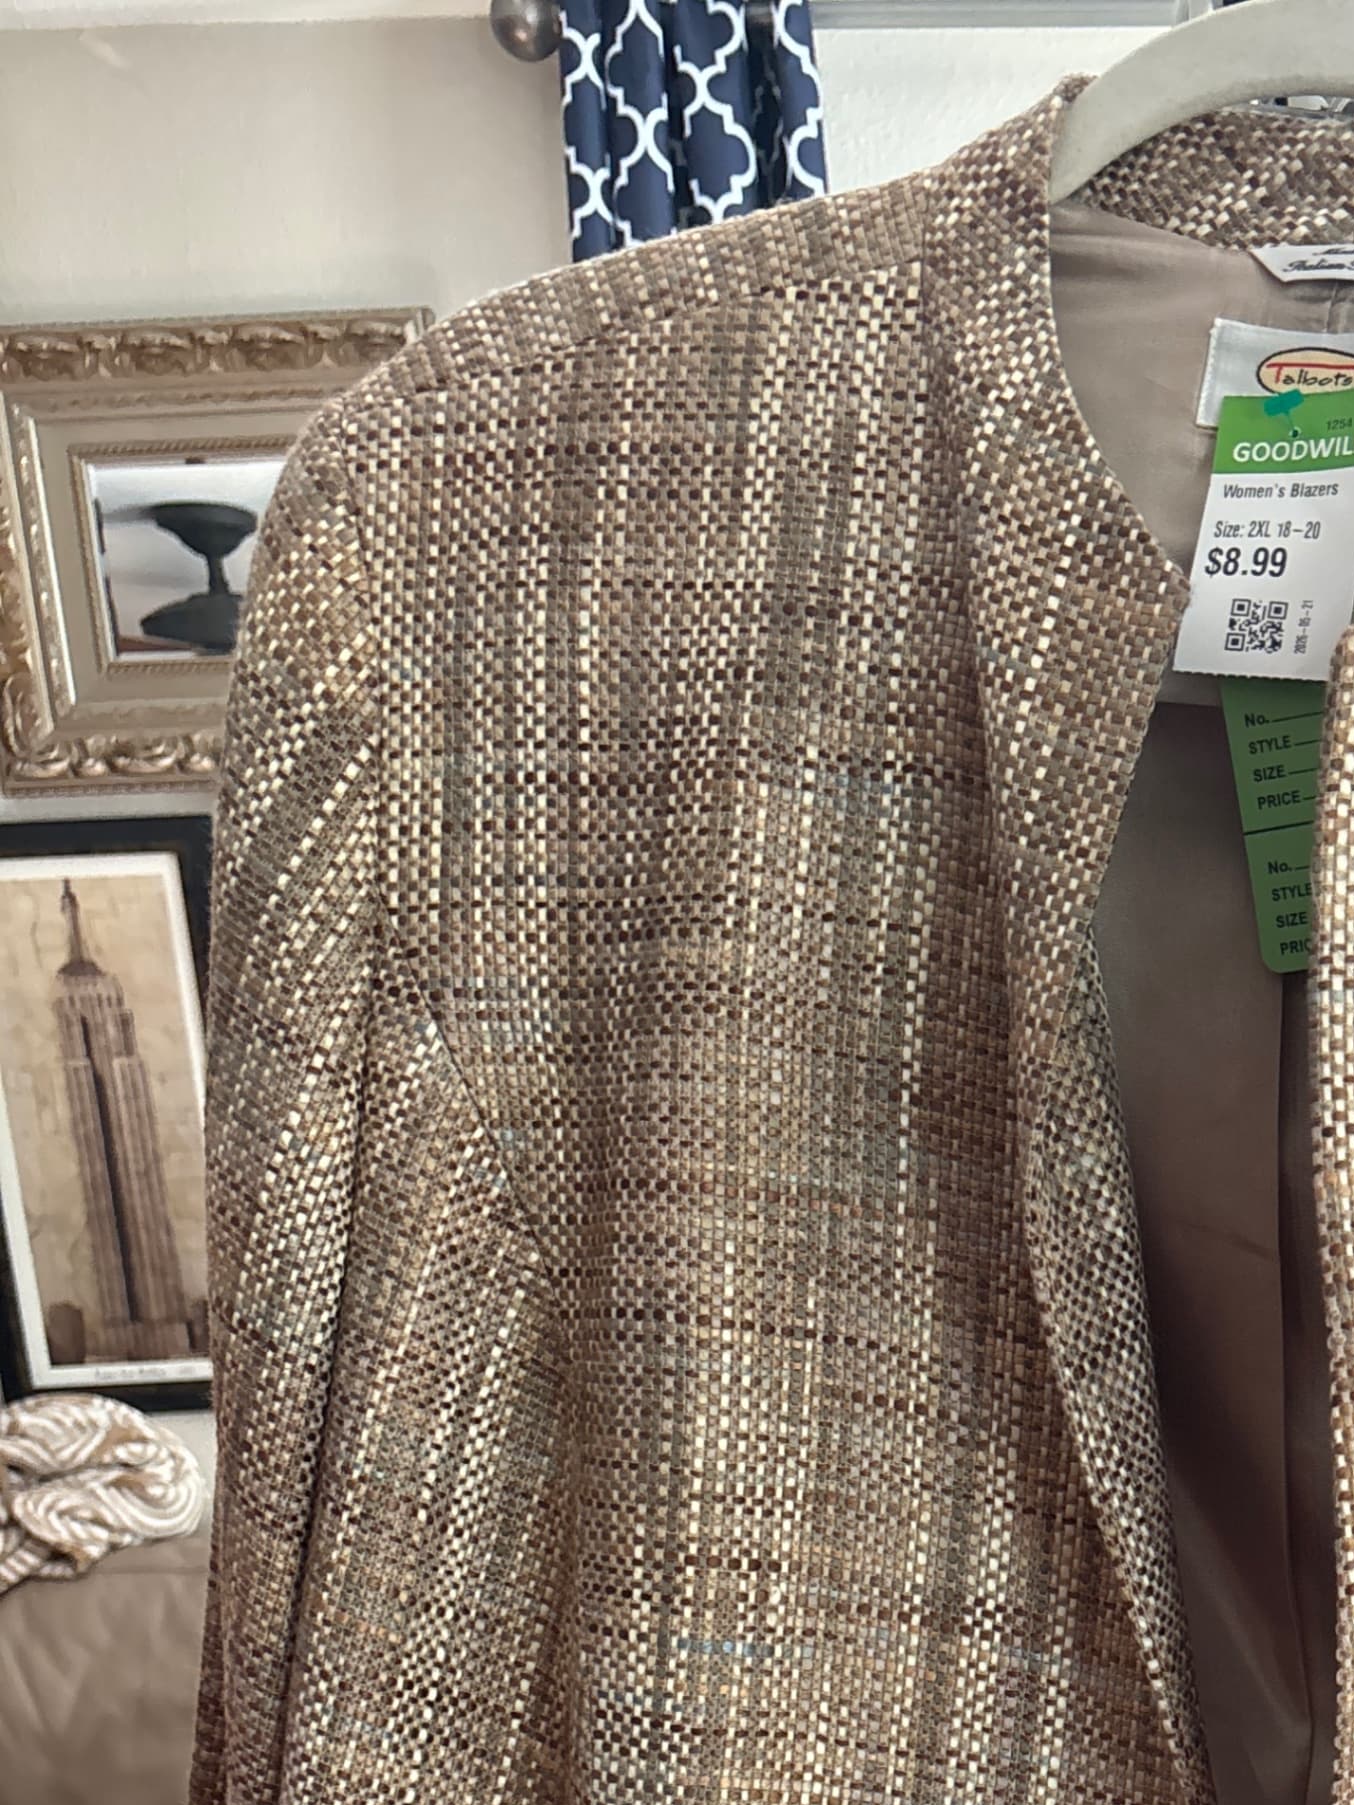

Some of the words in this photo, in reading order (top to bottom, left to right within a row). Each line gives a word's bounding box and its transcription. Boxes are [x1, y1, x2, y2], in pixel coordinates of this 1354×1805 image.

[1223, 483, 1286, 498] Women's
[1290, 483, 1339, 498] Blazers
[1213, 520, 1245, 538] Size:
[1248, 520, 1271, 538] 2XL
[1204, 547, 1288, 578] $8.99
[1244, 712, 1270, 728] No.
[1248, 735, 1292, 755] STYLE
[1253, 765, 1287, 783] SIZE
[1257, 790, 1301, 810] PRICE
[1268, 861, 1293, 875] No.
[1272, 882, 1313, 902] STYLE
[1276, 911, 1308, 929] SIZE
[1280, 938, 1313, 956] PRIC
